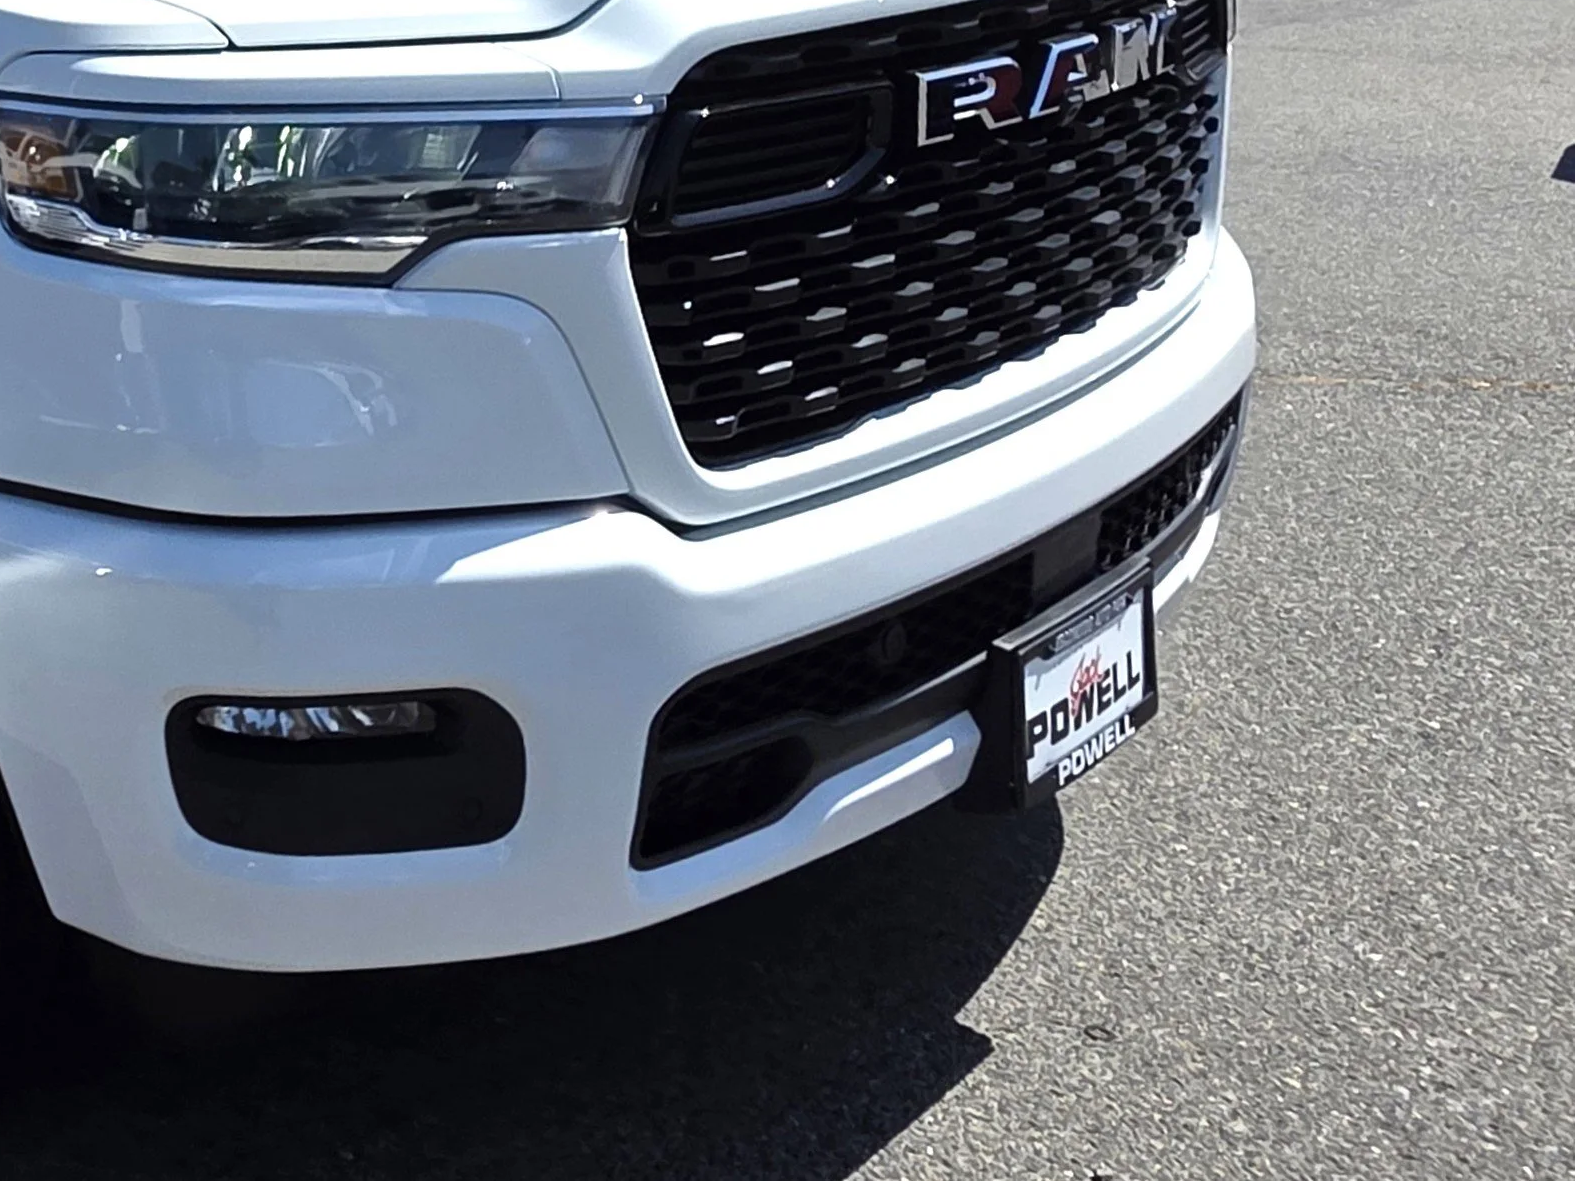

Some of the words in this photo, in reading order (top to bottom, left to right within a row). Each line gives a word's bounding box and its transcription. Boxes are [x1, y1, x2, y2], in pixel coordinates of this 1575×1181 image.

[915, 1, 1179, 147] RAM
[1026, 649, 1141, 762] POWELL
[1057, 713, 1136, 787] POWELL
